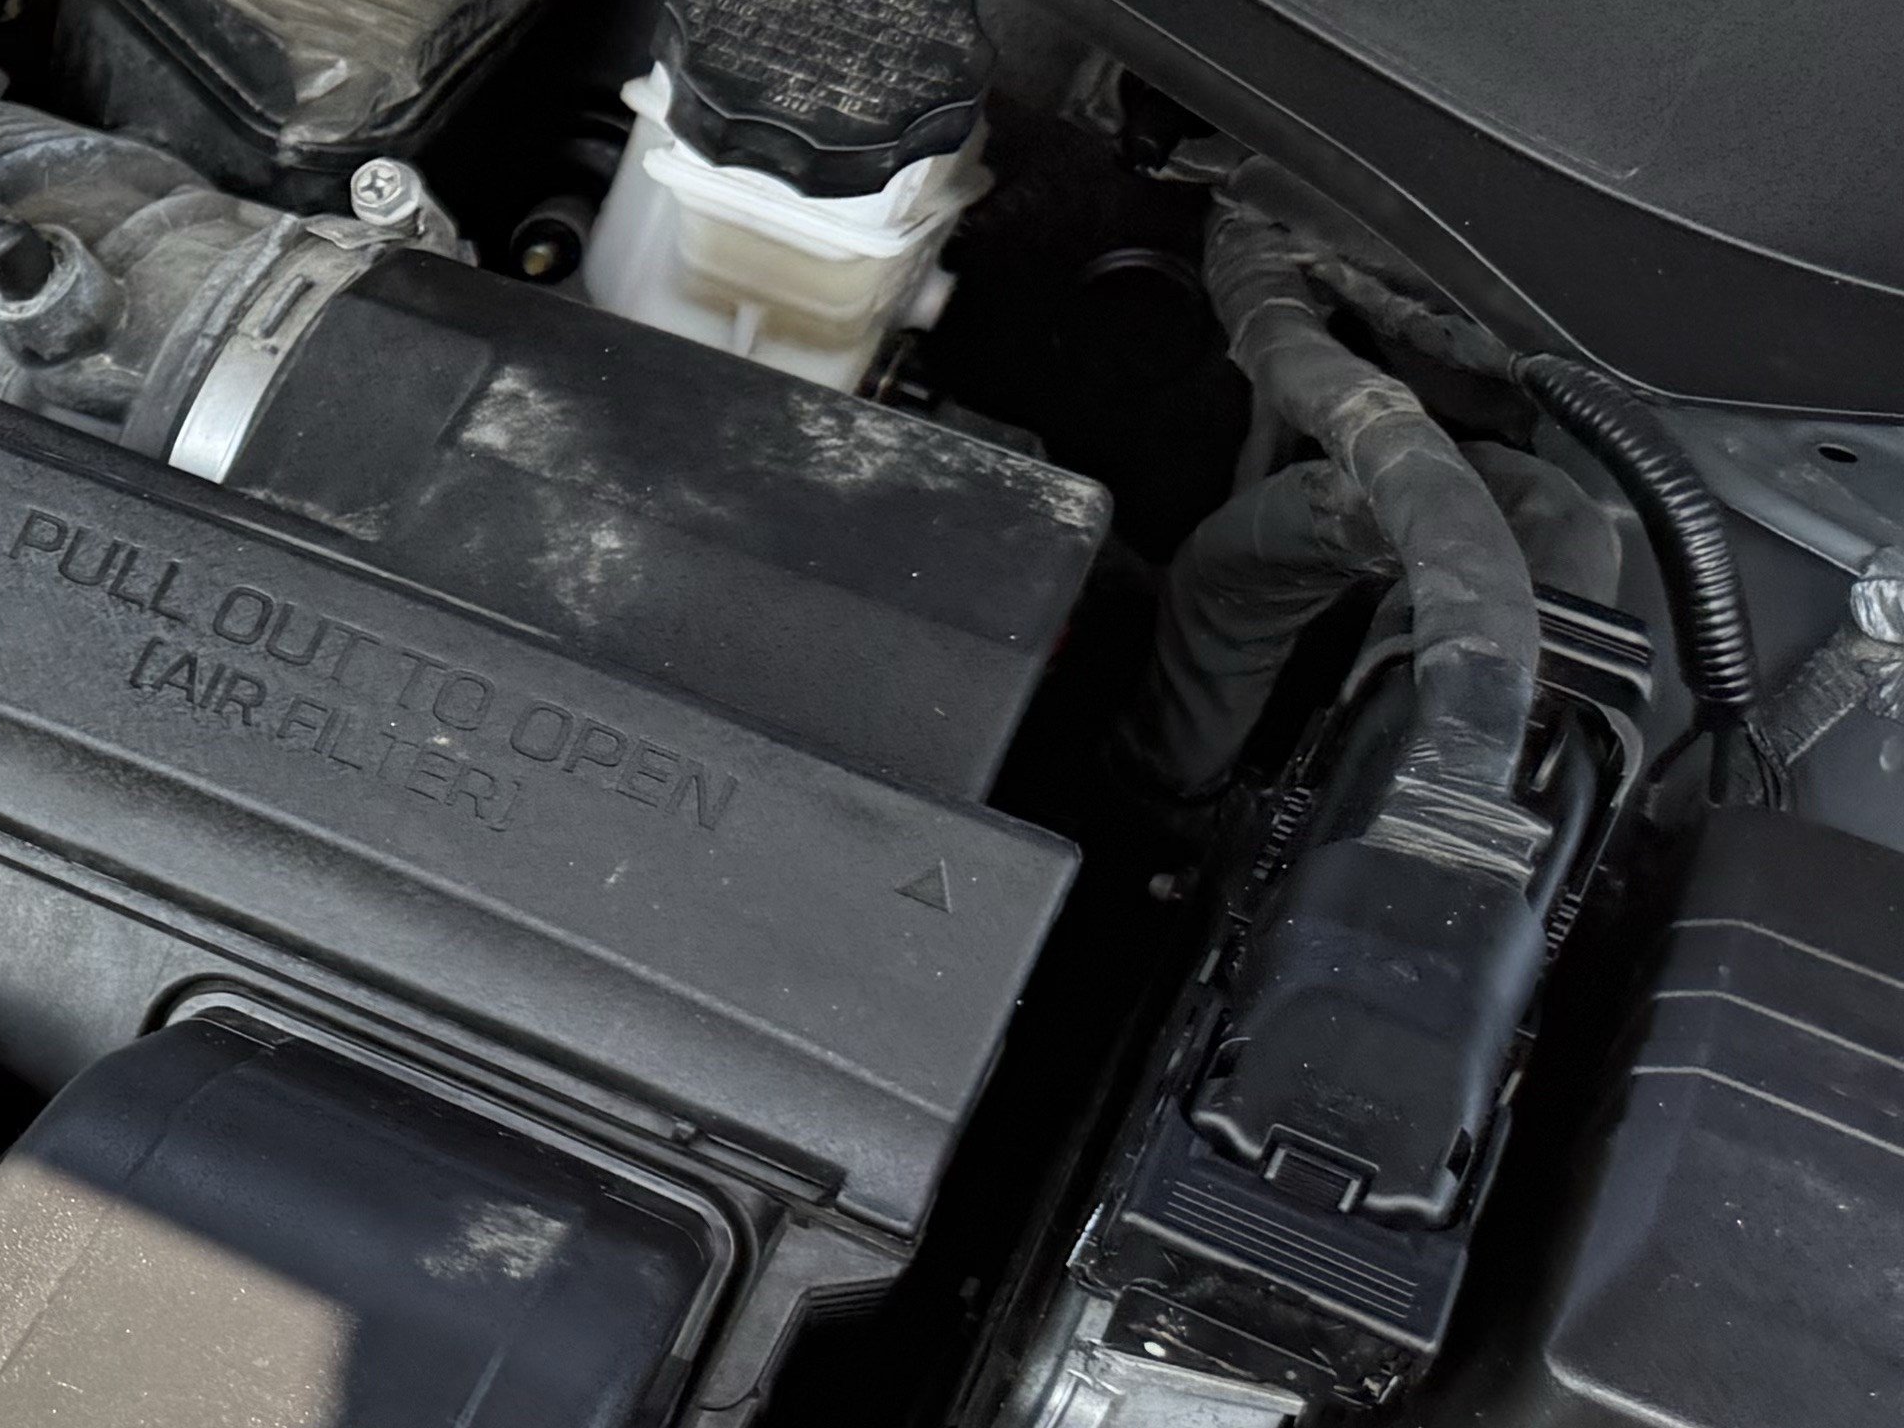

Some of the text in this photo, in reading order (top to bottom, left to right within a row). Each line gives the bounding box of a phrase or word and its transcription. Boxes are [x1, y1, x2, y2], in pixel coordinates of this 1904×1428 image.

[7, 508, 740, 832] PULL OUT TO OPEN
